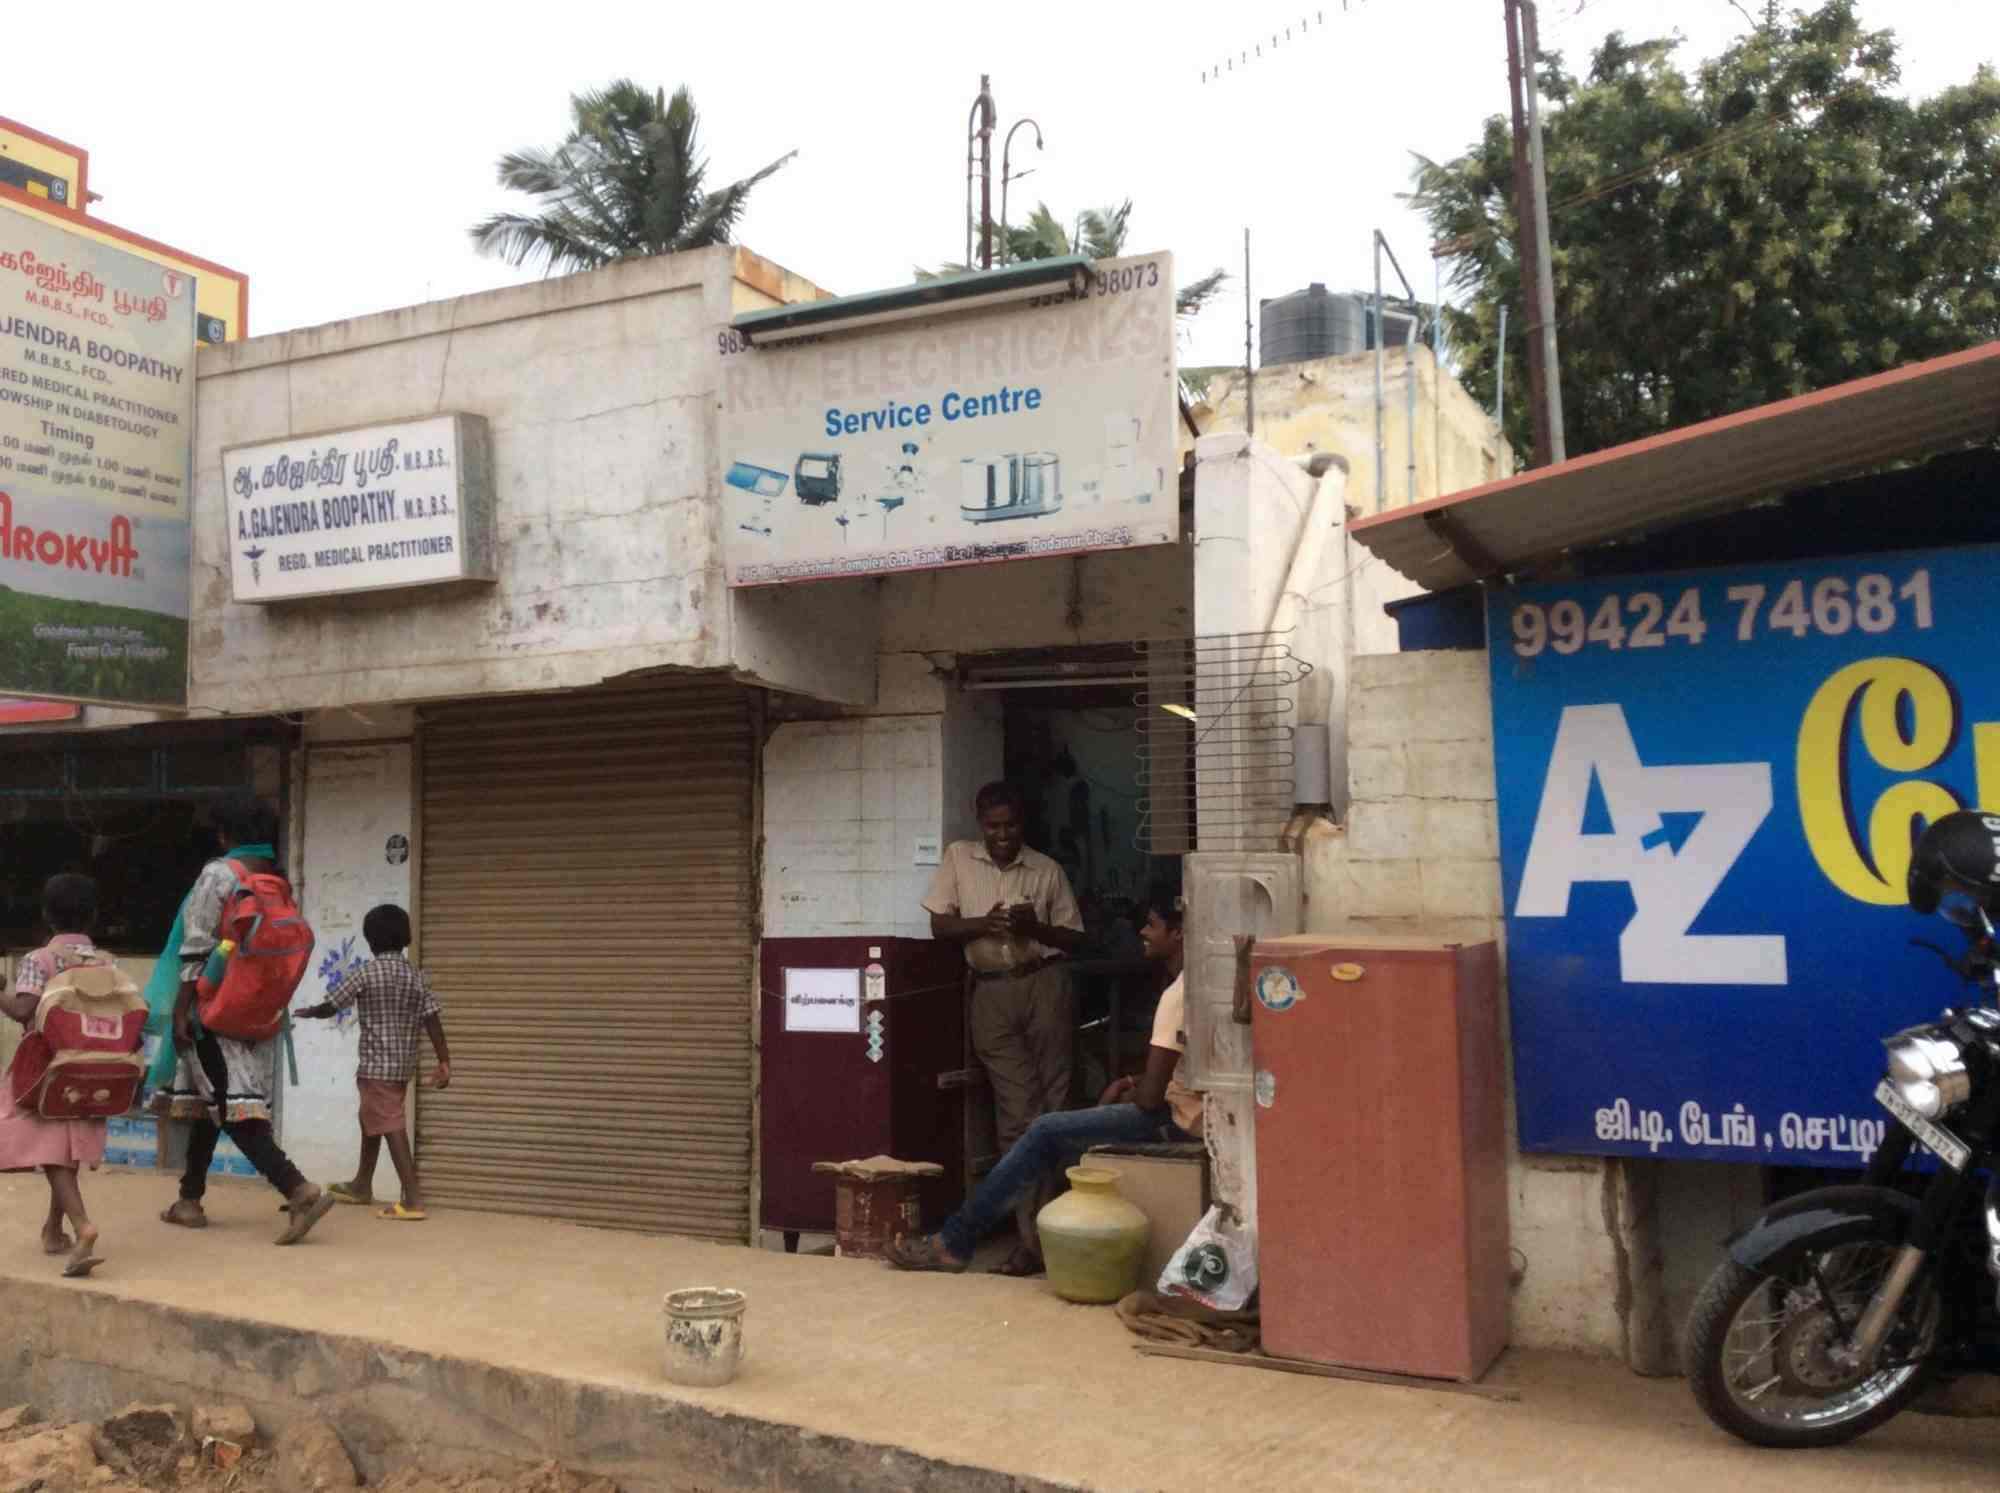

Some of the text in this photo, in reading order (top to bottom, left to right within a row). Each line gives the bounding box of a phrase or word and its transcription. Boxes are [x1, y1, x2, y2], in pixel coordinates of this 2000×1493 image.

[1096, 262, 1158, 297] 98073
[0, 316, 183, 384] JENDRA BOOPATHY
[0, 367, 179, 425] RED MEDICAL PRACTITIONER
[57, 402, 71, 416] IN
[73, 406, 159, 440] DIABETOLOGY
[825, 386, 1042, 437] Service Centre
[40, 420, 95, 450] Timing
[315, 547, 364, 567] MEDICAL
[368, 535, 454, 561] PRACTITIONER
[1511, 569, 1934, 657] 99424 74681
[1514, 702, 1789, 986] AZ
